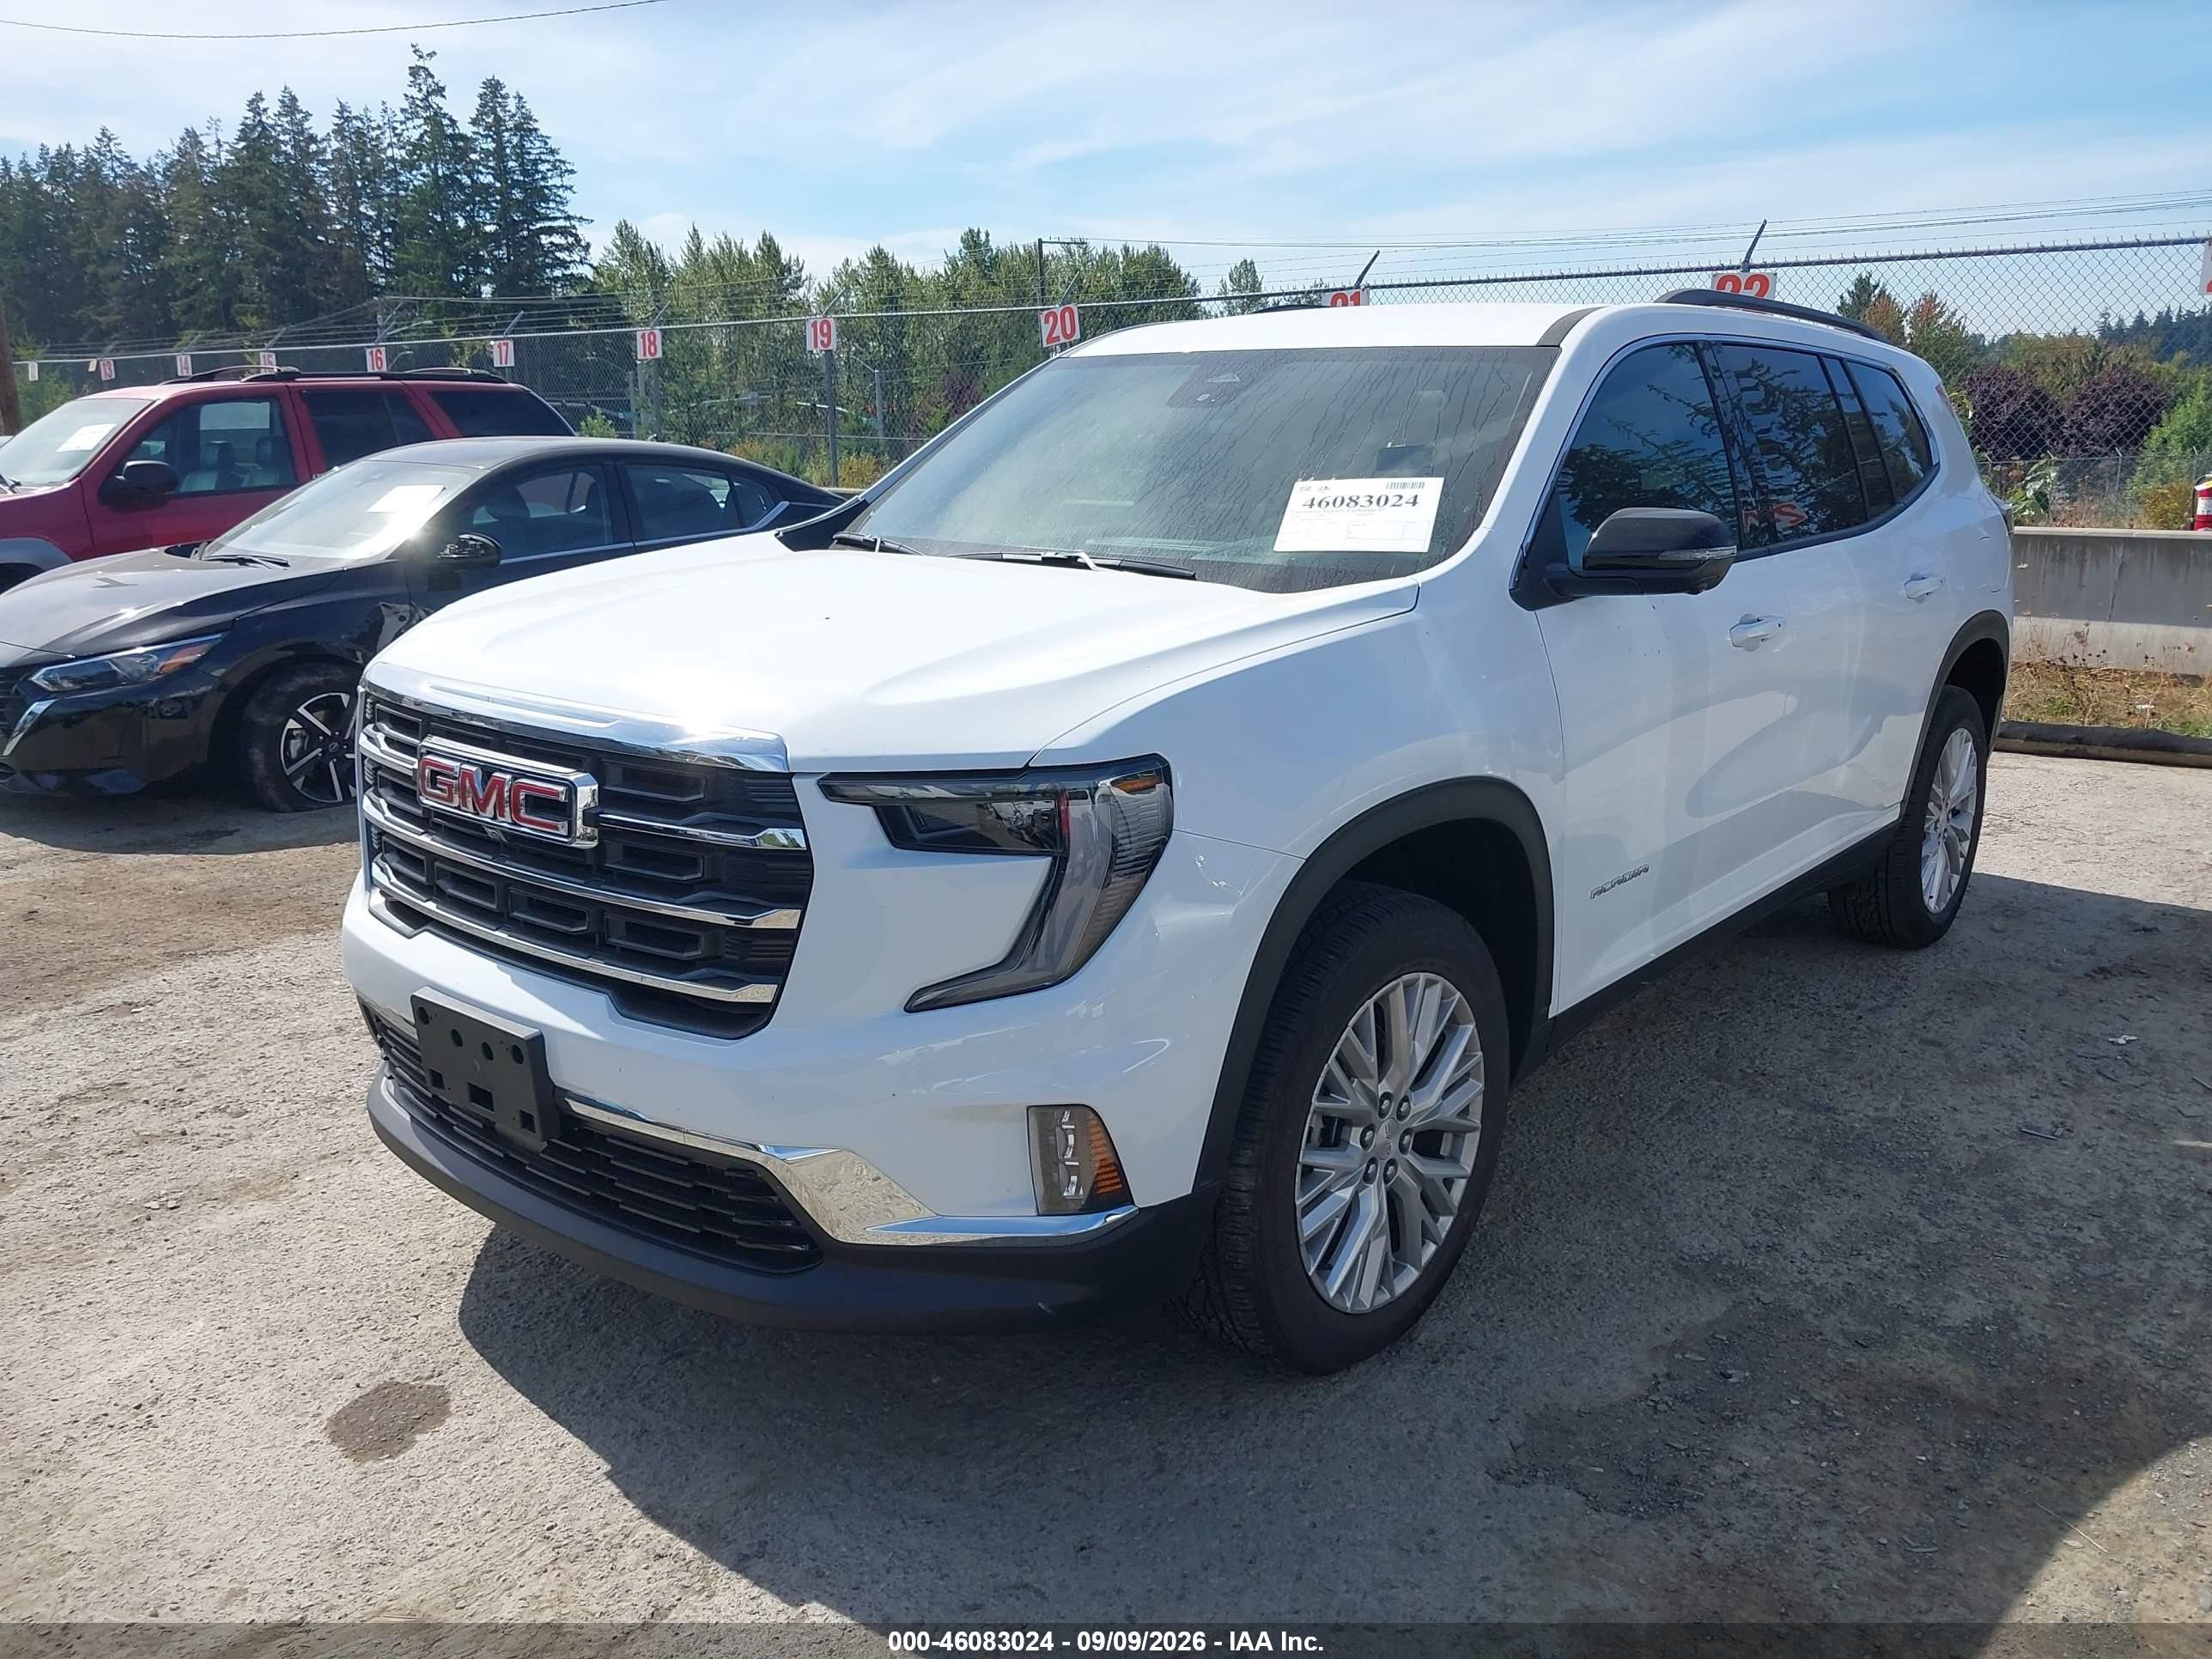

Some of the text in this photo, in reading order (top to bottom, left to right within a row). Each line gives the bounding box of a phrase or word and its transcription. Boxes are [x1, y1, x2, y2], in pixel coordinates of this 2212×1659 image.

[811, 319, 831, 348] 19
[1044, 307, 1076, 344] 20
[497, 342, 508, 365] 17
[641, 331, 657, 357] 18
[370, 349, 383, 371] 16
[1303, 495, 1419, 508] 46083024
[419, 754, 568, 836] GMC
